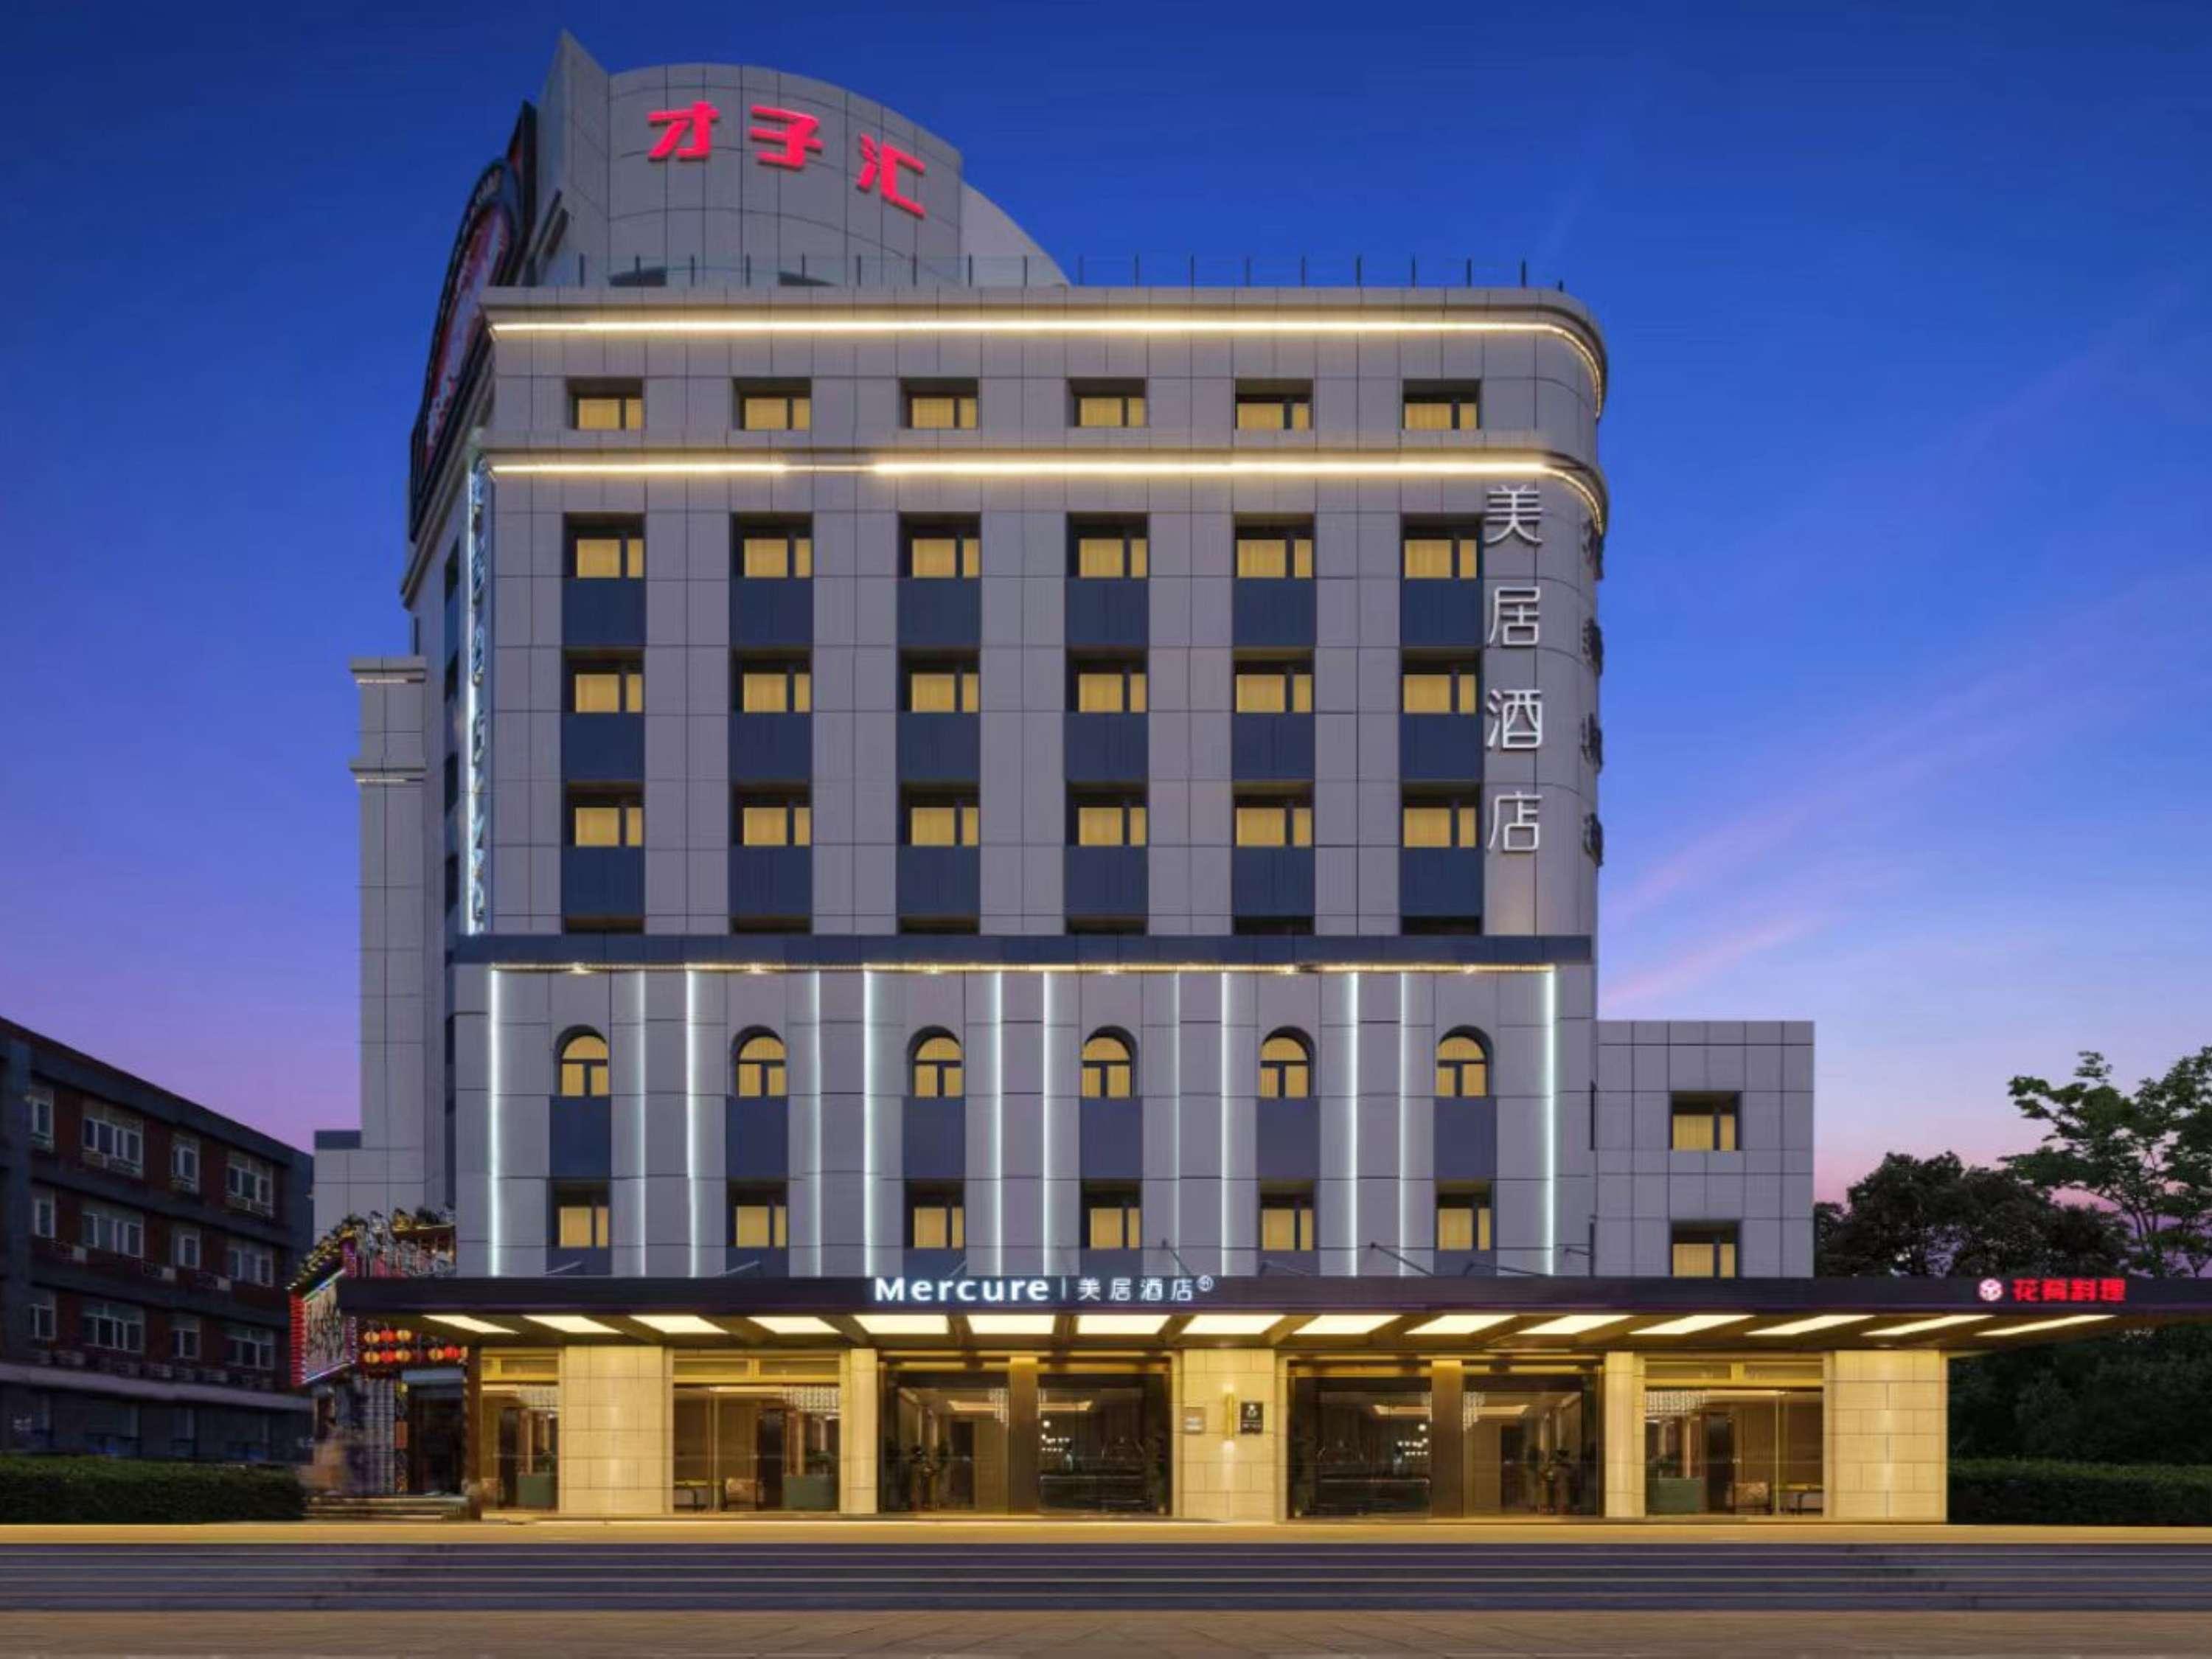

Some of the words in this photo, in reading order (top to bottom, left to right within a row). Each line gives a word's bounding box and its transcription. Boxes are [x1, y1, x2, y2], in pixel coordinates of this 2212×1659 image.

[647, 100, 927, 218] 才子汇
[1484, 484, 1543, 854] 美居酒店
[873, 1276, 1050, 1301] Mercure
